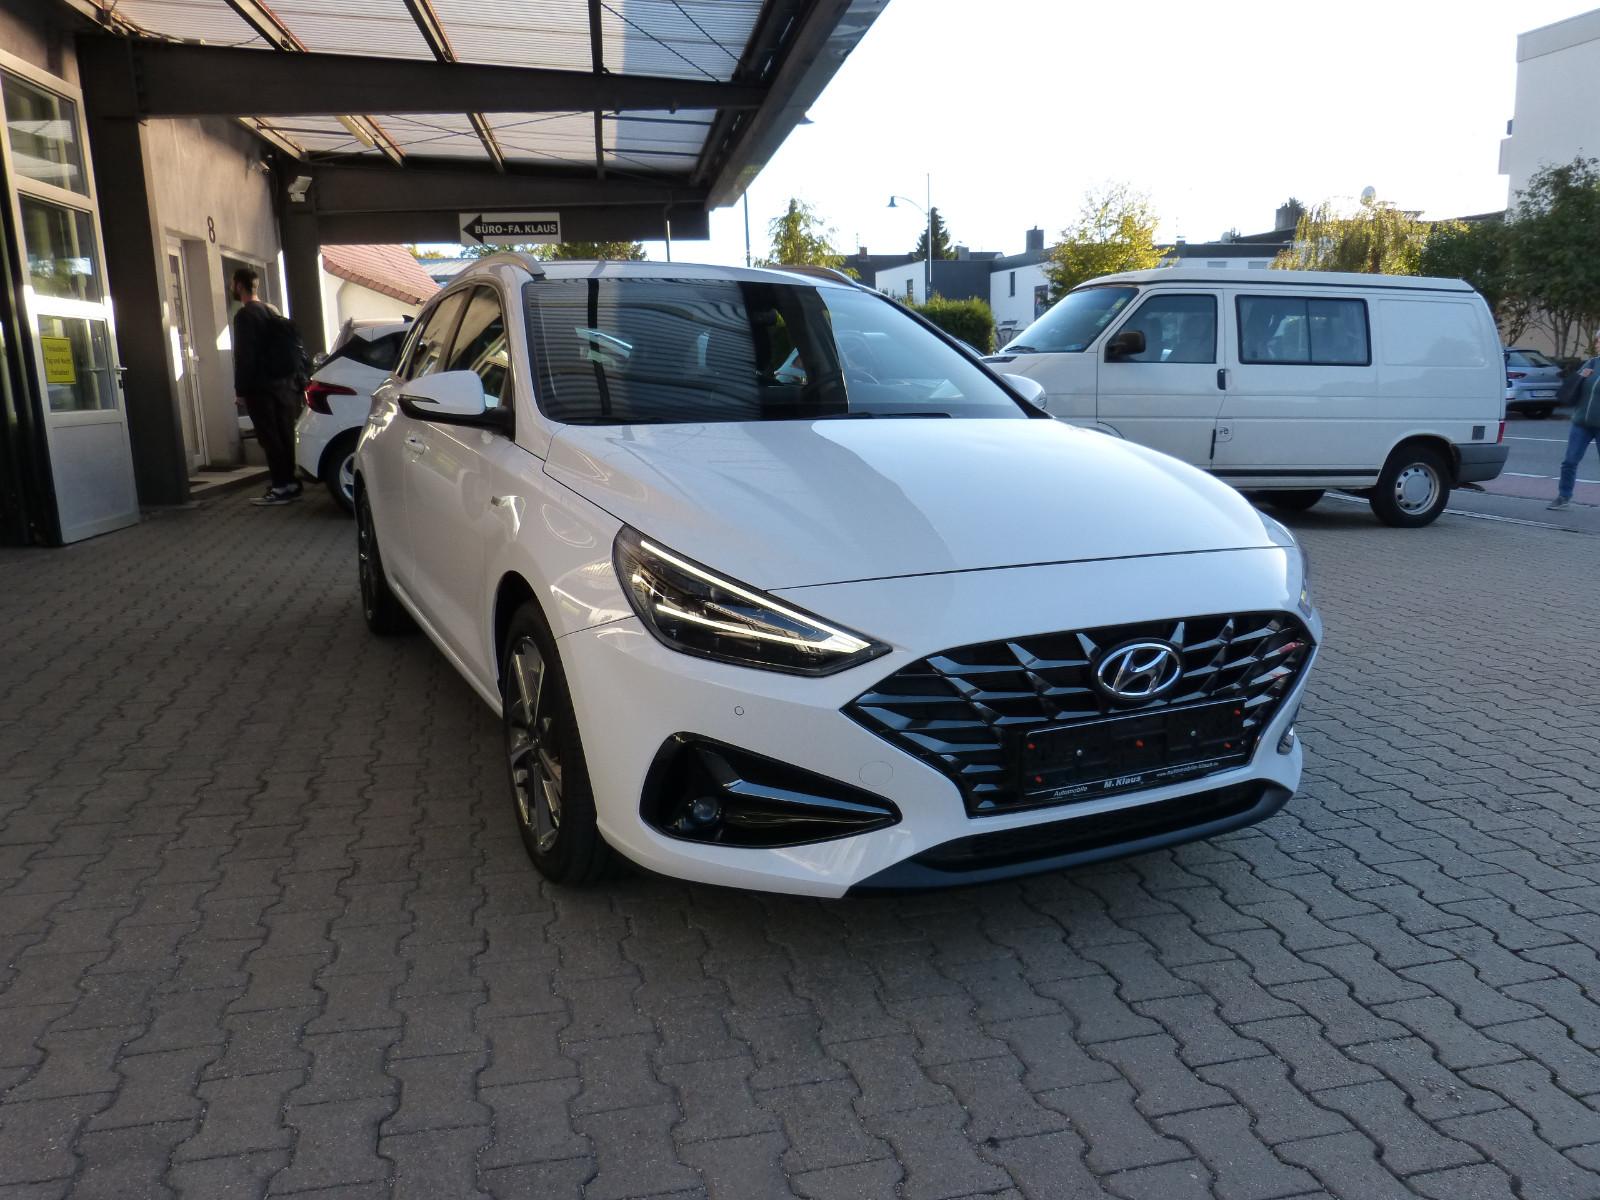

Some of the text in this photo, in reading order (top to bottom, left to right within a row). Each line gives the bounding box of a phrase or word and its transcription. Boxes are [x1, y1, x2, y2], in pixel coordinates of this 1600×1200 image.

[206, 215, 216, 244] 8
[1103, 775, 1142, 789] M. Klaus
